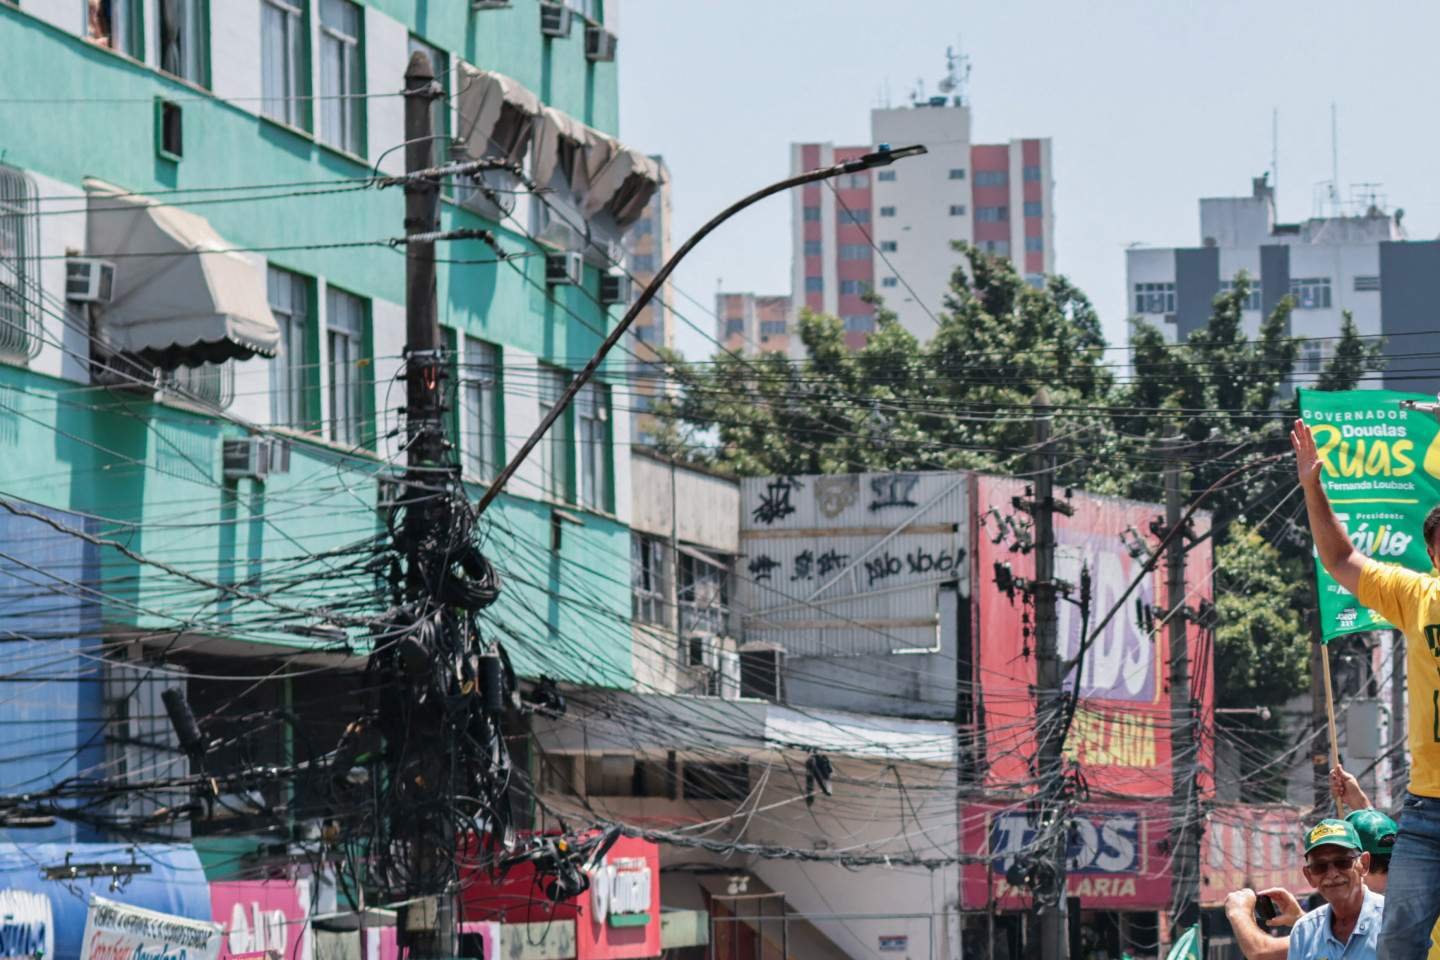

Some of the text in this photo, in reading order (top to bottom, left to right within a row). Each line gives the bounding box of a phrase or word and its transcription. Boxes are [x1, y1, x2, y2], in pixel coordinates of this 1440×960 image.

[1302, 409, 1408, 421] GOVERNADOR
[1341, 423, 1407, 438] Douglas
[1309, 424, 1416, 479] Ruas
[1328, 480, 1415, 492] Fernanda Louback
[995, 876, 1137, 898] PALARIA
